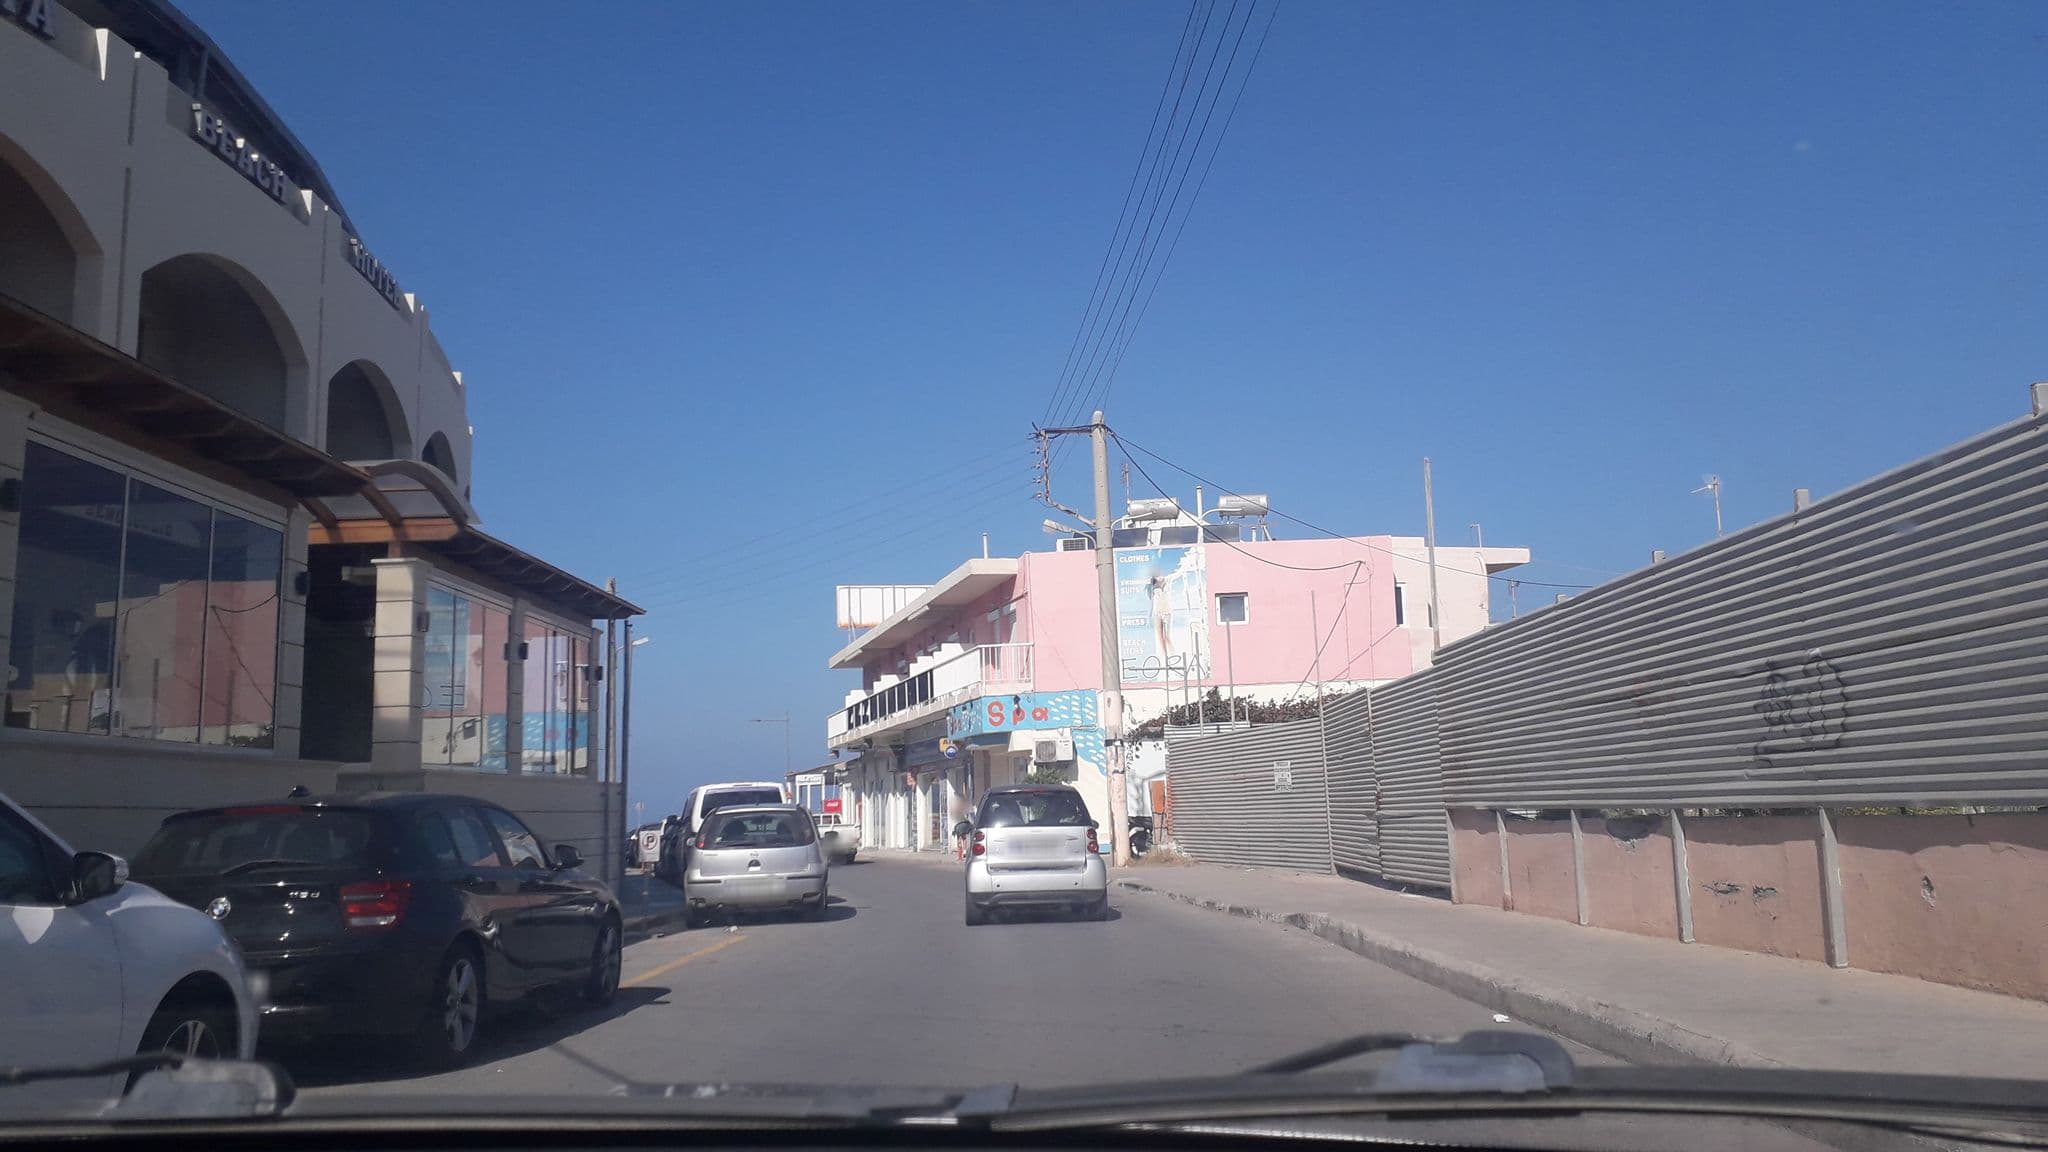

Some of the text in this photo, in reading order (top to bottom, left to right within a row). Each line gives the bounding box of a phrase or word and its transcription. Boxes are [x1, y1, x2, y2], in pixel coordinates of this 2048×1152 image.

[0, 0, 402, 306] A BEACH HOTEL
[1119, 554, 1150, 563] CLOTHES
[987, 700, 1049, 727] Spa
